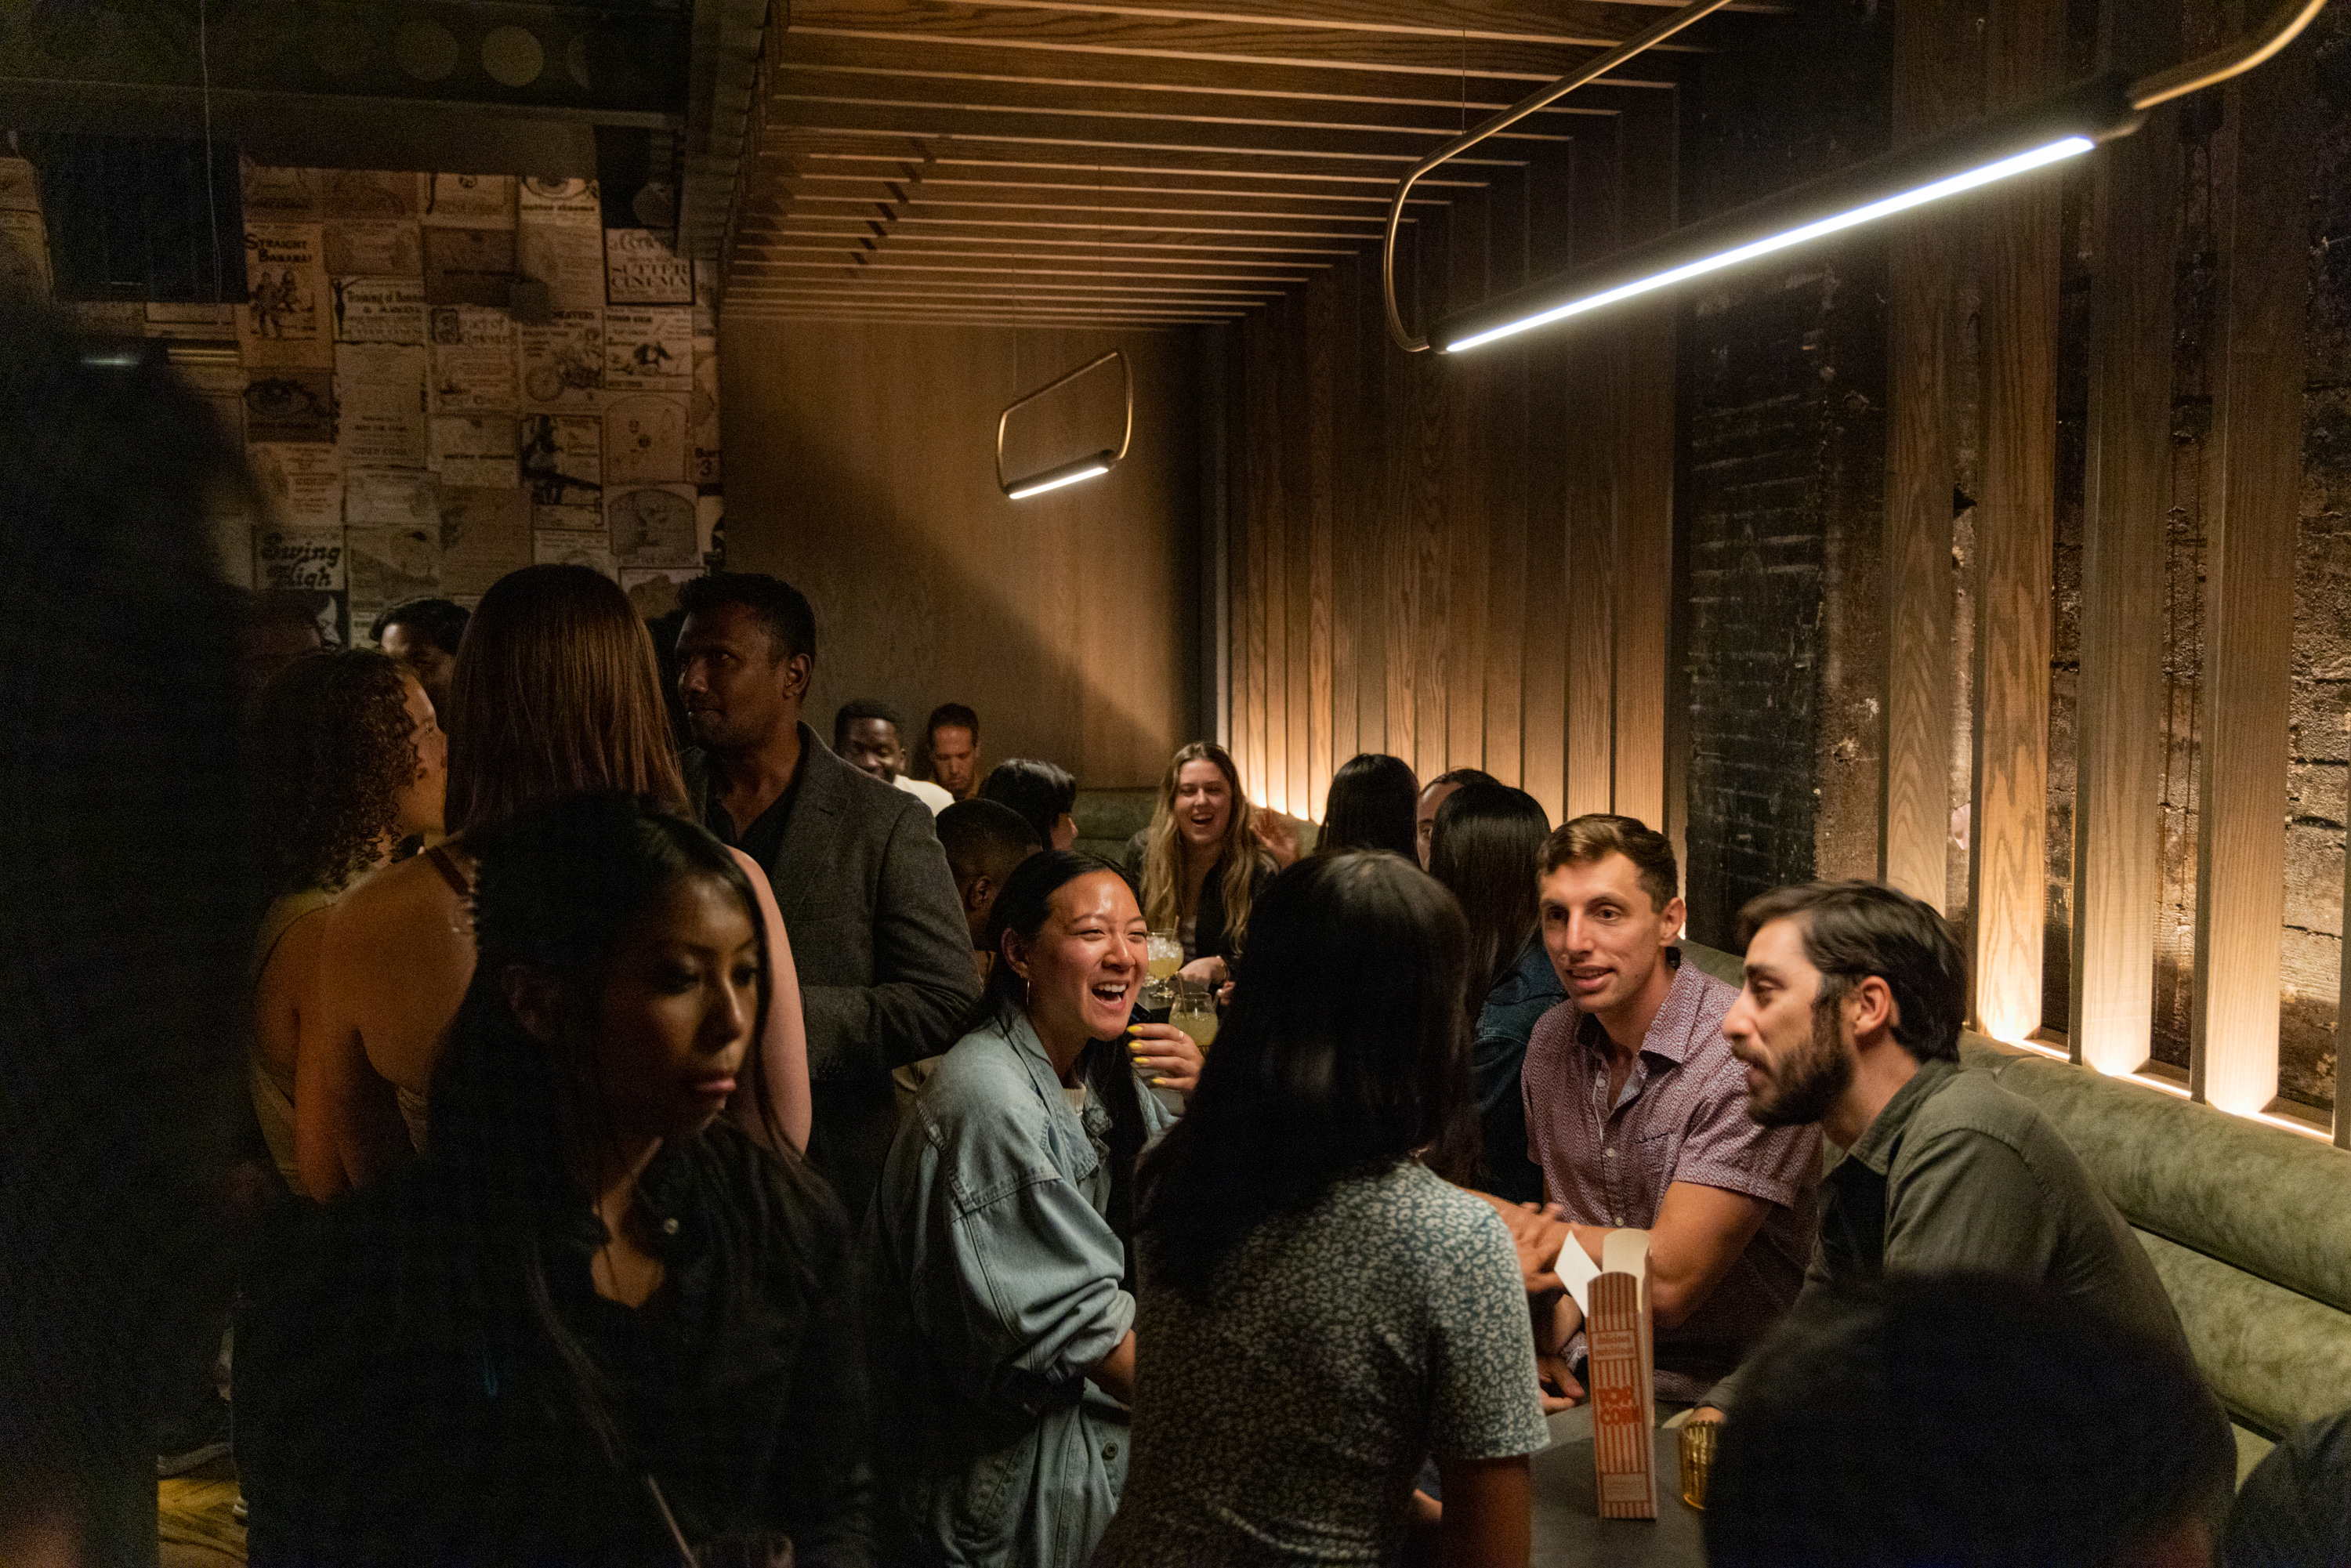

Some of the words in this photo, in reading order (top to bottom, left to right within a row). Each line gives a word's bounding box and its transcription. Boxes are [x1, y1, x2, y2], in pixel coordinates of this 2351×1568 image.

[261, 531, 341, 567] Swing
[1597, 1385, 1636, 1408] POP
[1599, 1405, 1640, 1425] CORN
